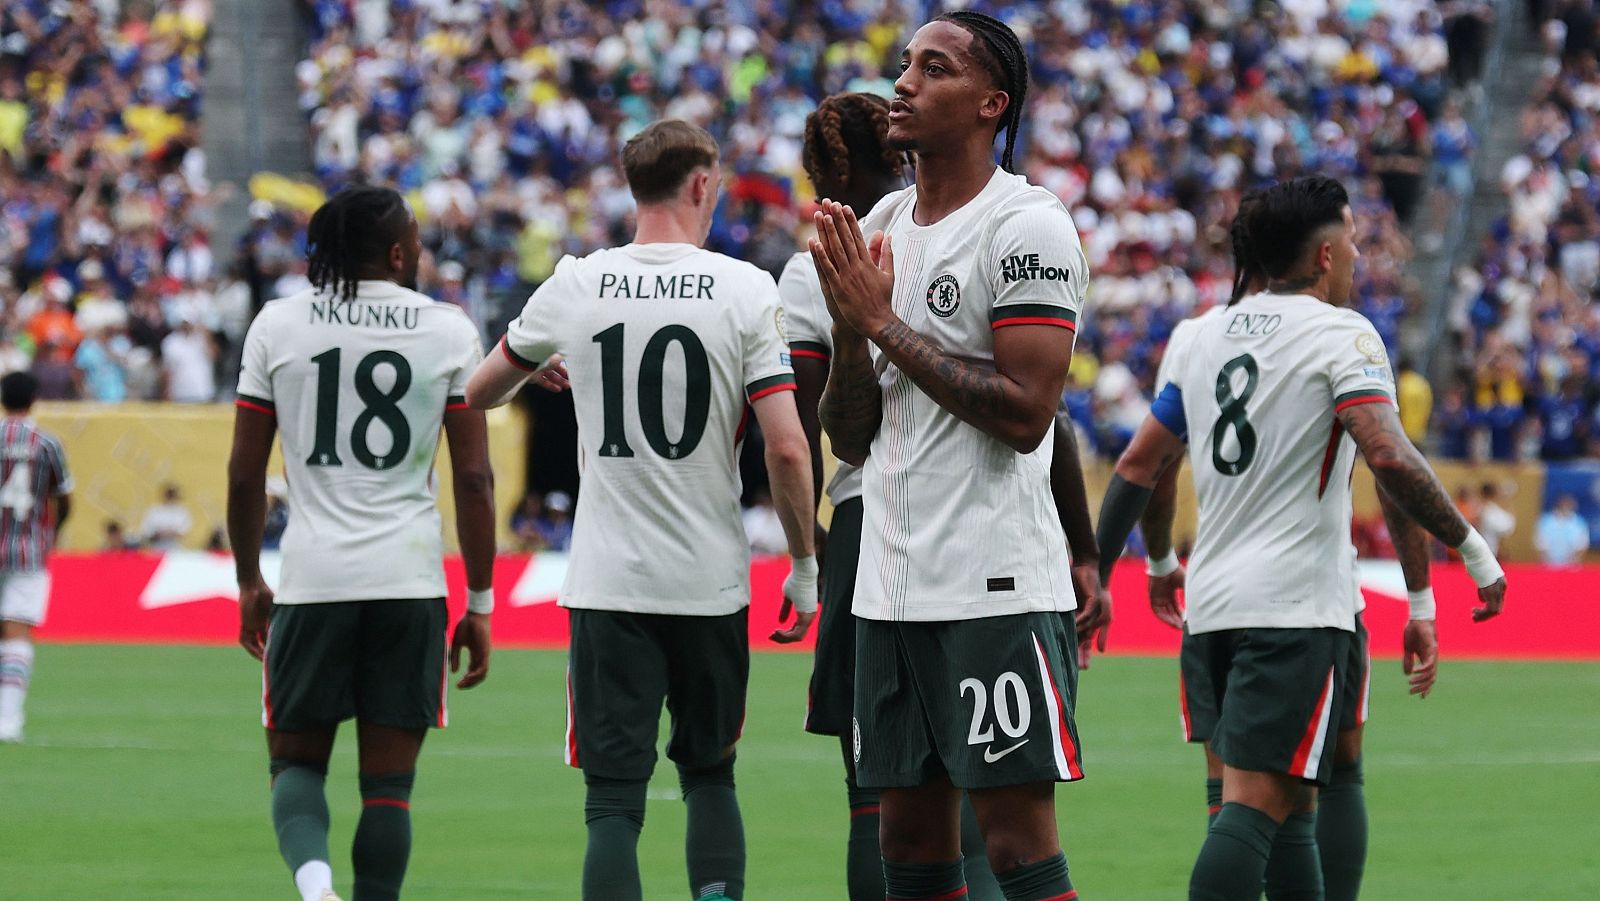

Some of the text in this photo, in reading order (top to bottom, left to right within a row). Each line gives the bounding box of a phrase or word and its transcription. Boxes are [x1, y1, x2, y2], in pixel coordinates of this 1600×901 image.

[1001, 253, 1039, 271] LIVE
[1003, 267, 1069, 283] NATION
[598, 273, 715, 300] PALMER
[309, 301, 419, 330] NKUNKU
[1226, 313, 1282, 335] ENZO
[592, 322, 712, 461] 10
[305, 347, 413, 471] 18
[1212, 353, 1260, 477] 8
[959, 671, 1031, 746] 20
